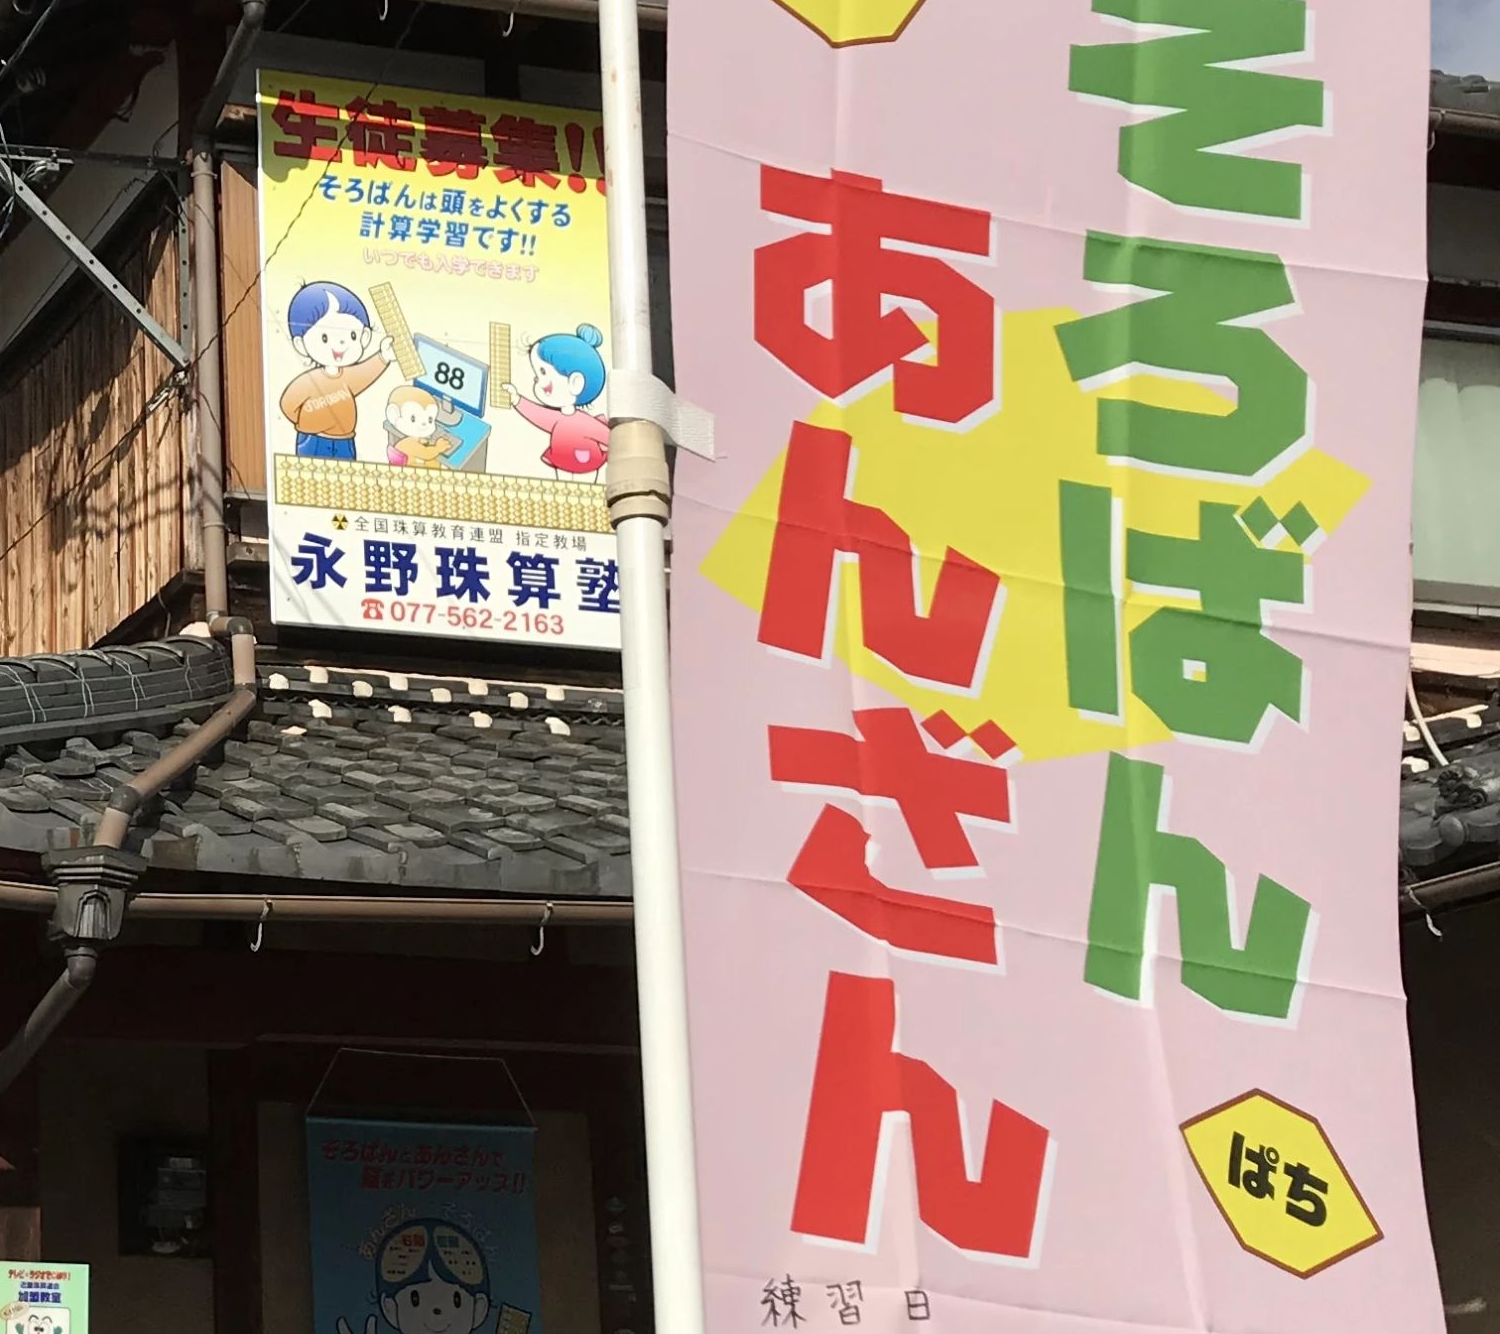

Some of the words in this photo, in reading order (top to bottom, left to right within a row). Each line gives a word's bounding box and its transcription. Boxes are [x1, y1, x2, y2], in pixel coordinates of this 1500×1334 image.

[318, 175, 572, 229] そろばんは頭をよくする
[360, 211, 537, 255] 計算学習です!!
[362, 247, 540, 283] いつでも入学できます
[434, 361, 465, 390] 88
[354, 516, 504, 545] 全国珠算教育連盟
[515, 529, 588, 552] 指定教場
[291, 532, 621, 614] 永野珠算塾
[390, 601, 565, 635] 077-562-2163
[753, 163, 1049, 1259] あんざん
[1228, 1131, 1328, 1227] ぱち
[761, 1274, 931, 1329] 練習日
